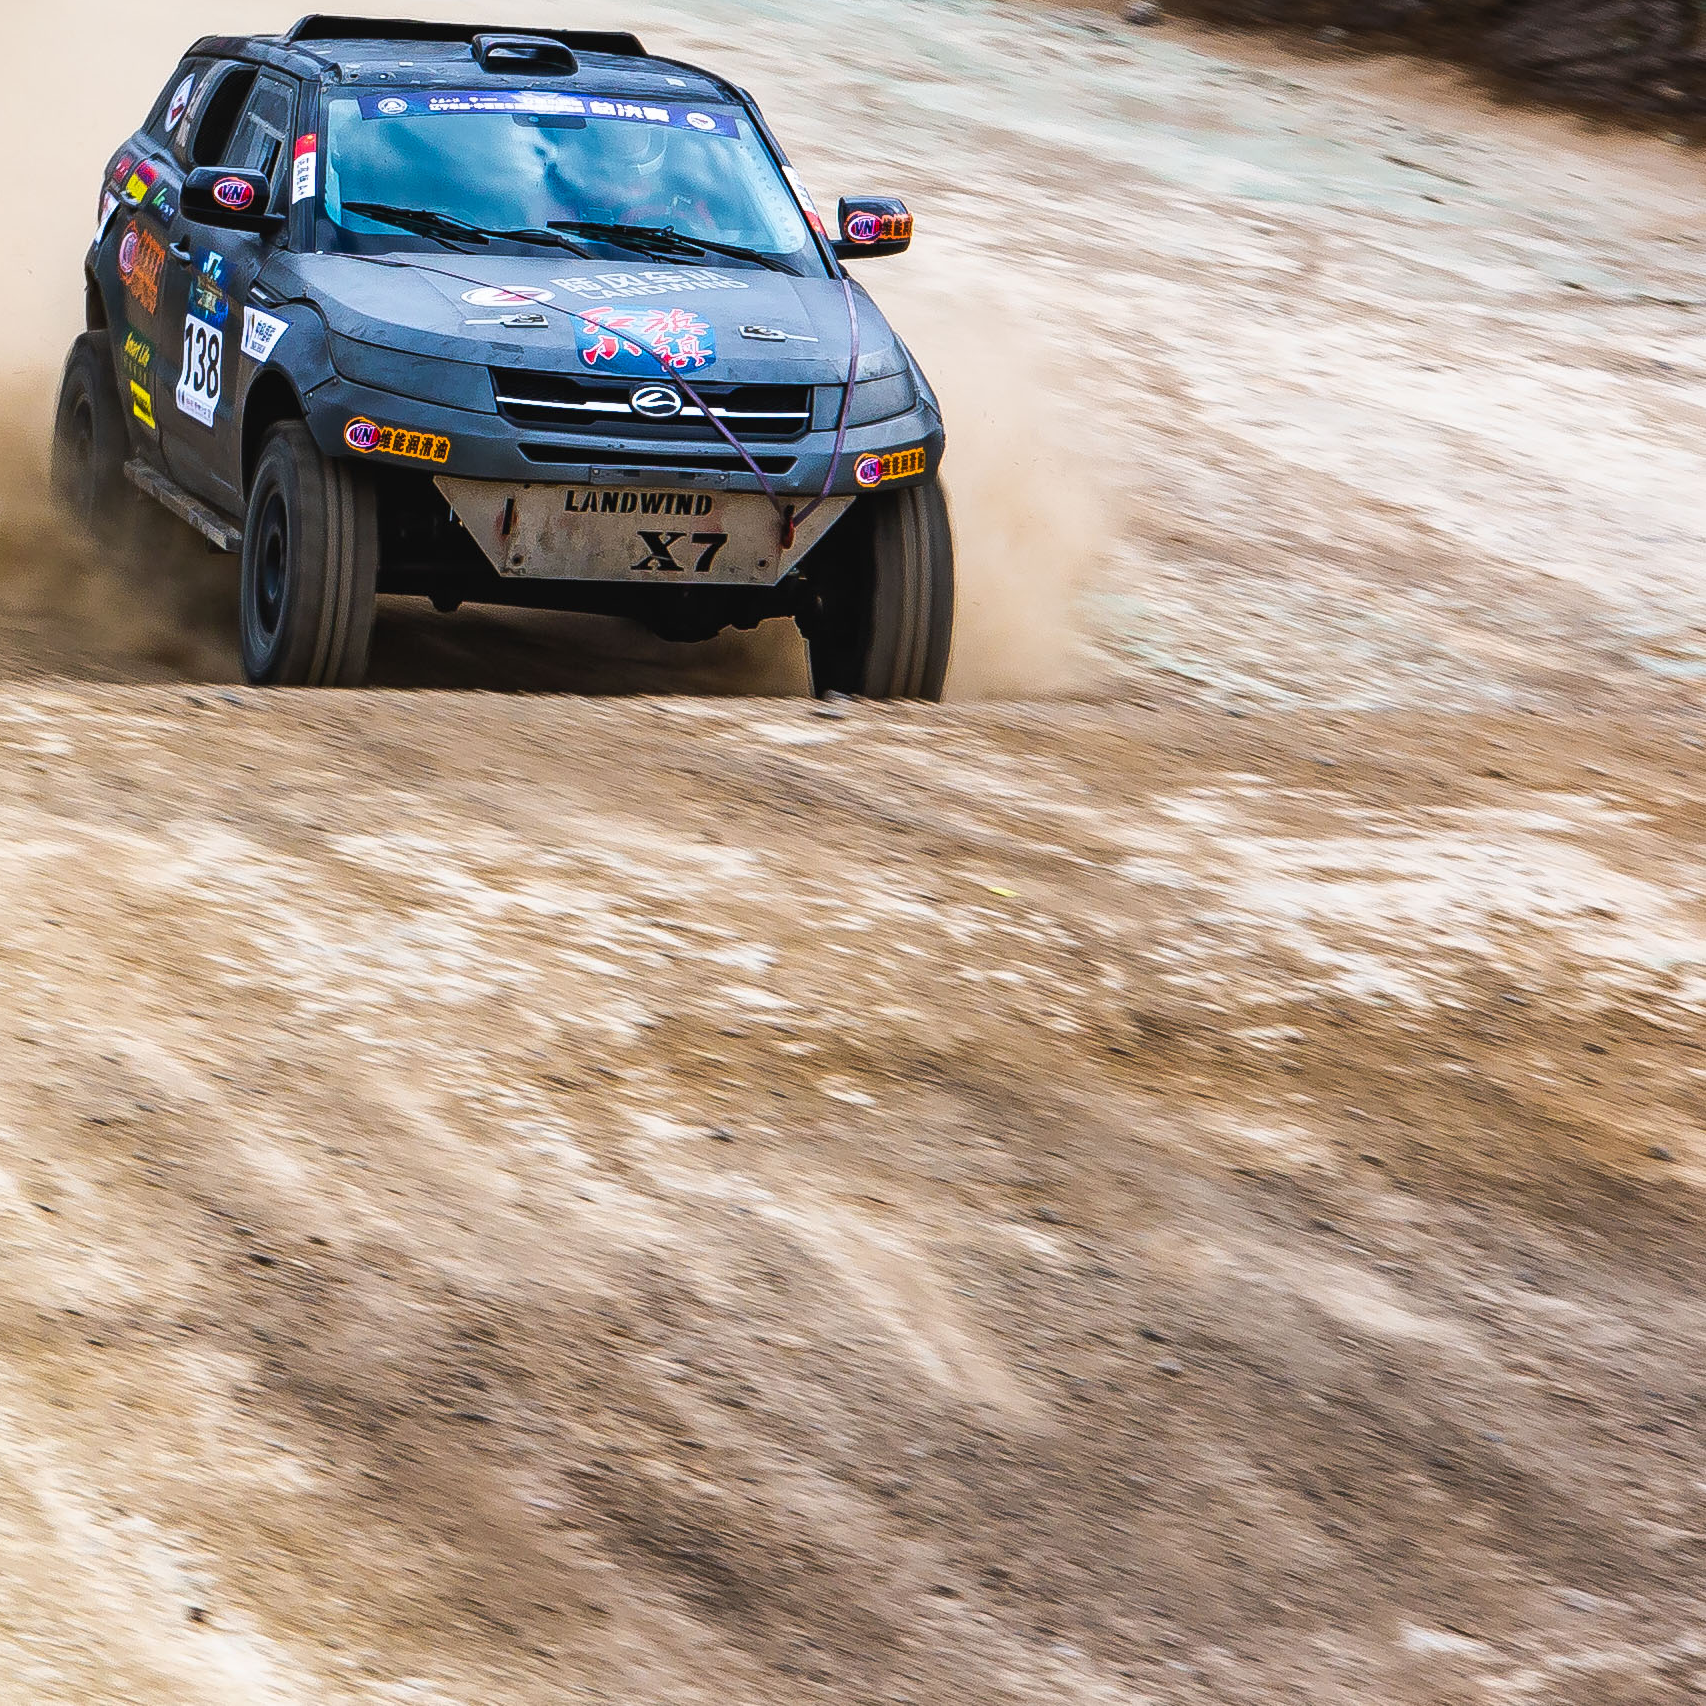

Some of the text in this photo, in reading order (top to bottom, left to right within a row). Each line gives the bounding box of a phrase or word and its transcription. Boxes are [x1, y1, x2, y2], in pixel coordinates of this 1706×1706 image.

[576, 278, 750, 300] LANDWIND
[184, 323, 220, 399] 138
[564, 490, 713, 516] LANDWIND
[630, 530, 729, 573] X7
